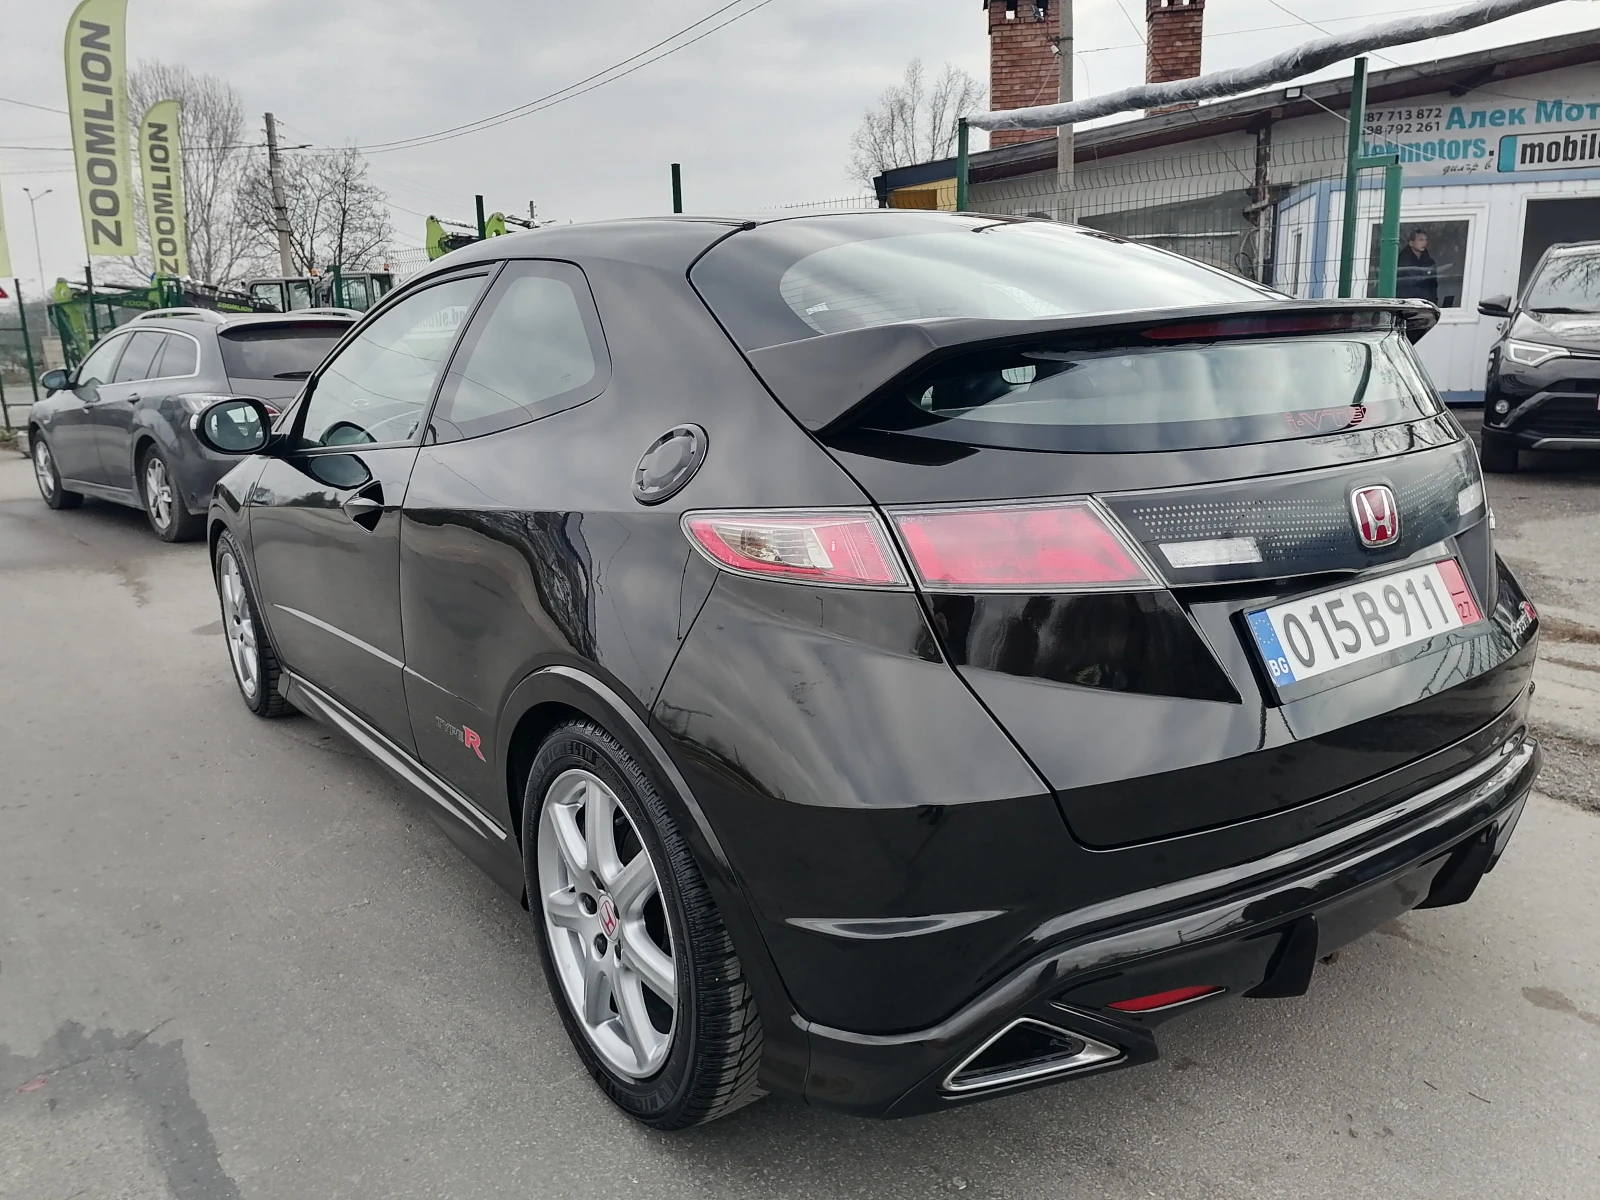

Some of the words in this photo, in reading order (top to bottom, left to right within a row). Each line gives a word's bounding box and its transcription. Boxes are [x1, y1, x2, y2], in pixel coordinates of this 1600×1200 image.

[1364, 110, 1383, 123] 87
[1387, 110, 1413, 121] 713
[1416, 107, 1442, 119] 872
[1387, 123, 1413, 135] 792
[1416, 121, 1441, 133] 261
[1445, 106, 1528, 130] Алек
[79, 19, 123, 247] ZOOMLION
[1519, 133, 1600, 165] mobil
[147, 121, 180, 274] ZOOMLION
[1283, 574, 1449, 668] 015B911
[1457, 600, 1473, 618] 27
[1269, 659, 1289, 677] BG
[462, 724, 487, 763] R
